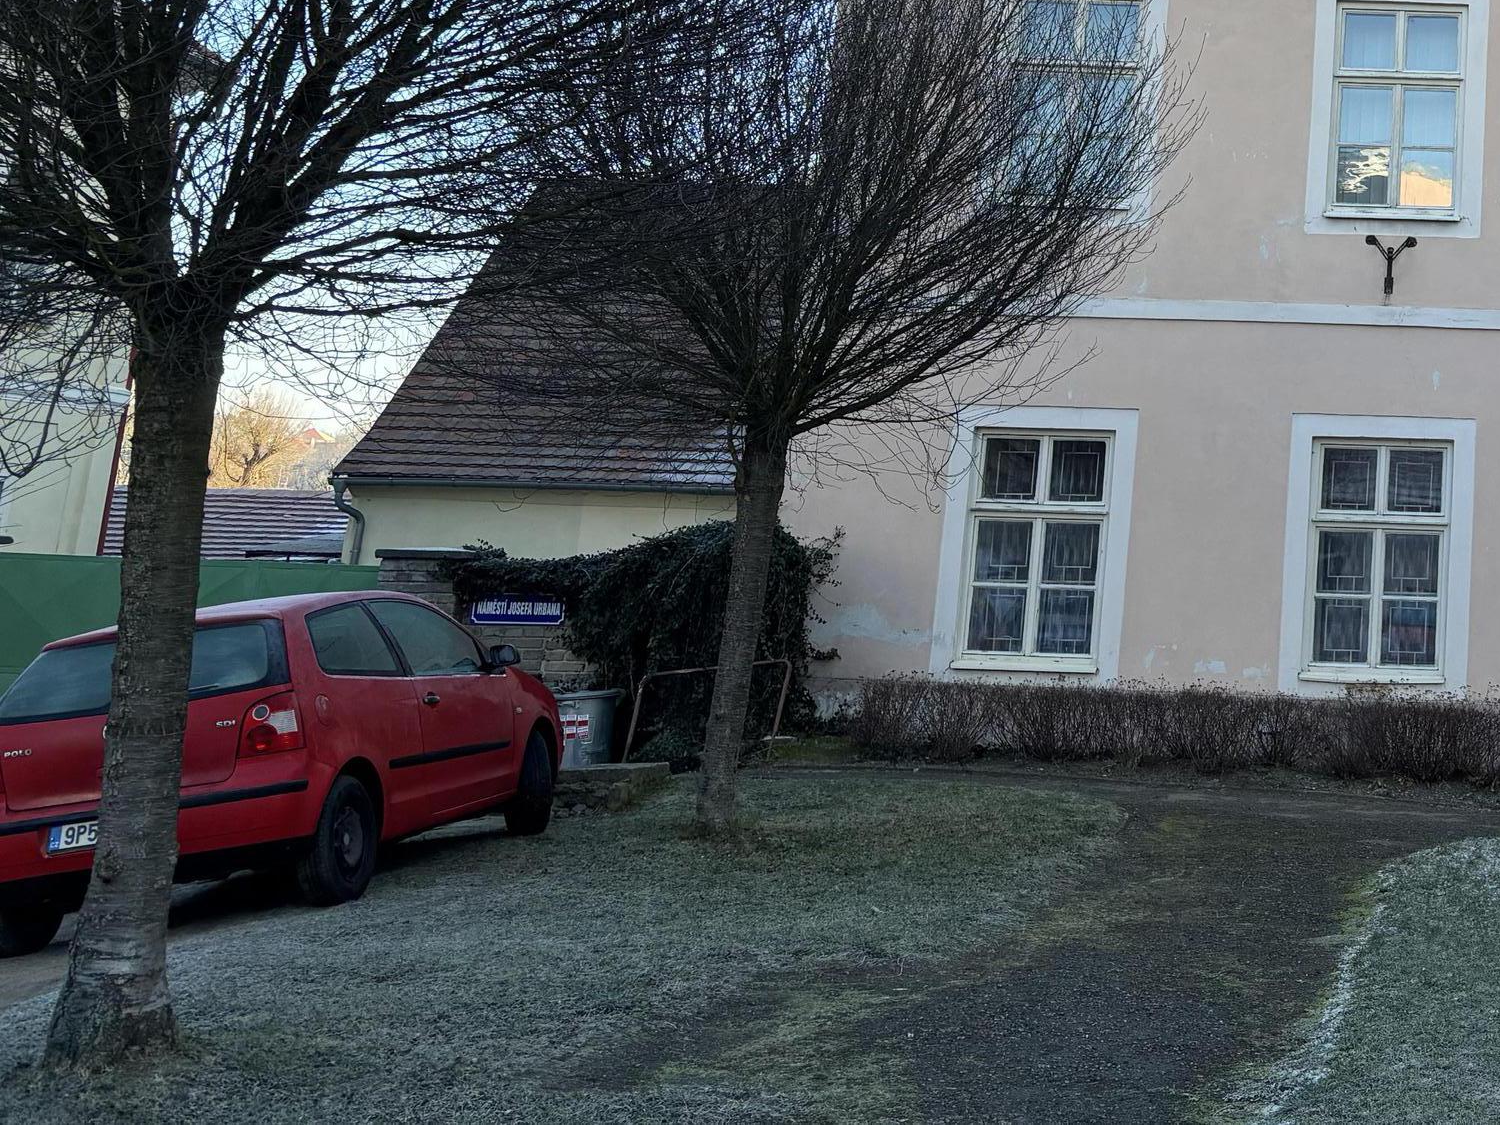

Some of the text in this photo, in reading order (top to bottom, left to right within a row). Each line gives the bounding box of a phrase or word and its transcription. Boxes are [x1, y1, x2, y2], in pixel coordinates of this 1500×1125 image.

[476, 598, 561, 616] NÁMĚSTÍ JOSEFA URBANA
